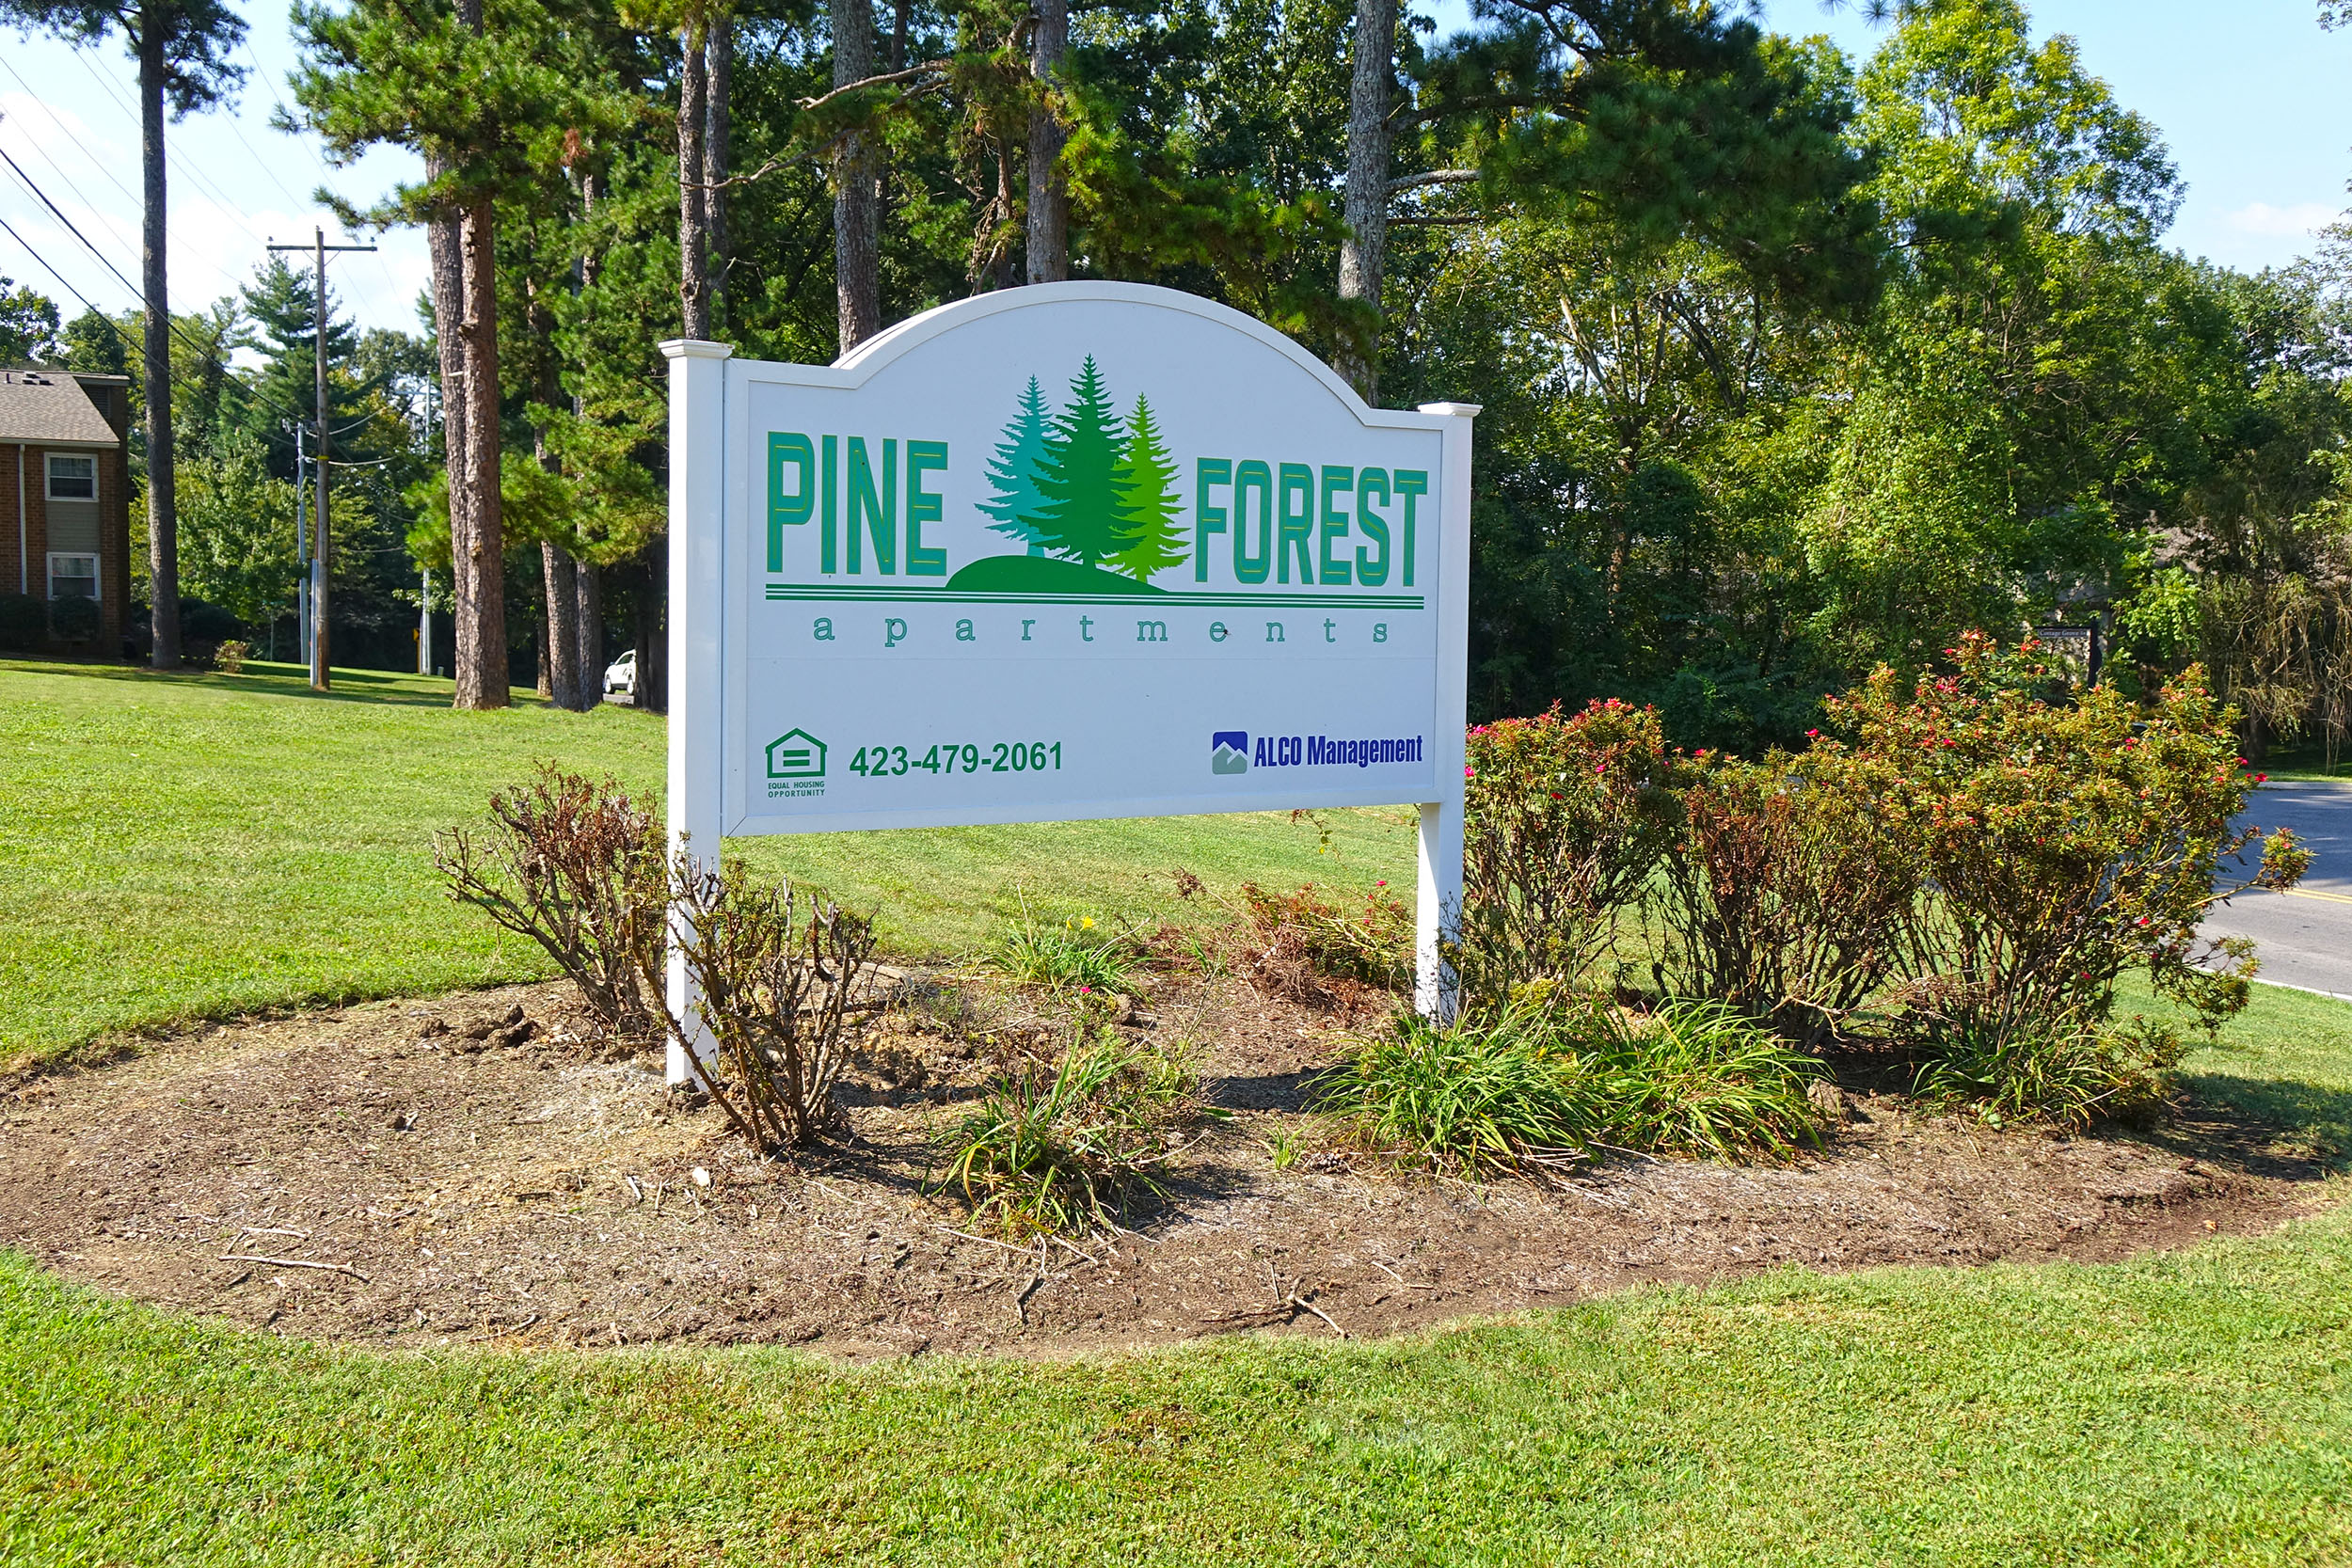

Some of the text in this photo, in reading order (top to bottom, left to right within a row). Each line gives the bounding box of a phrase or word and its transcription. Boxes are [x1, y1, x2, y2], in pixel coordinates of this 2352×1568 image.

[767, 431, 1428, 588] PINE FOREST
[814, 615, 1388, 648] apartments
[849, 741, 1062, 777] 423-479-2061
[1253, 735, 1423, 768] ALCO Management
[768, 789, 826, 799] OPPORTUNITY
[793, 780, 825, 788] HOUSING
